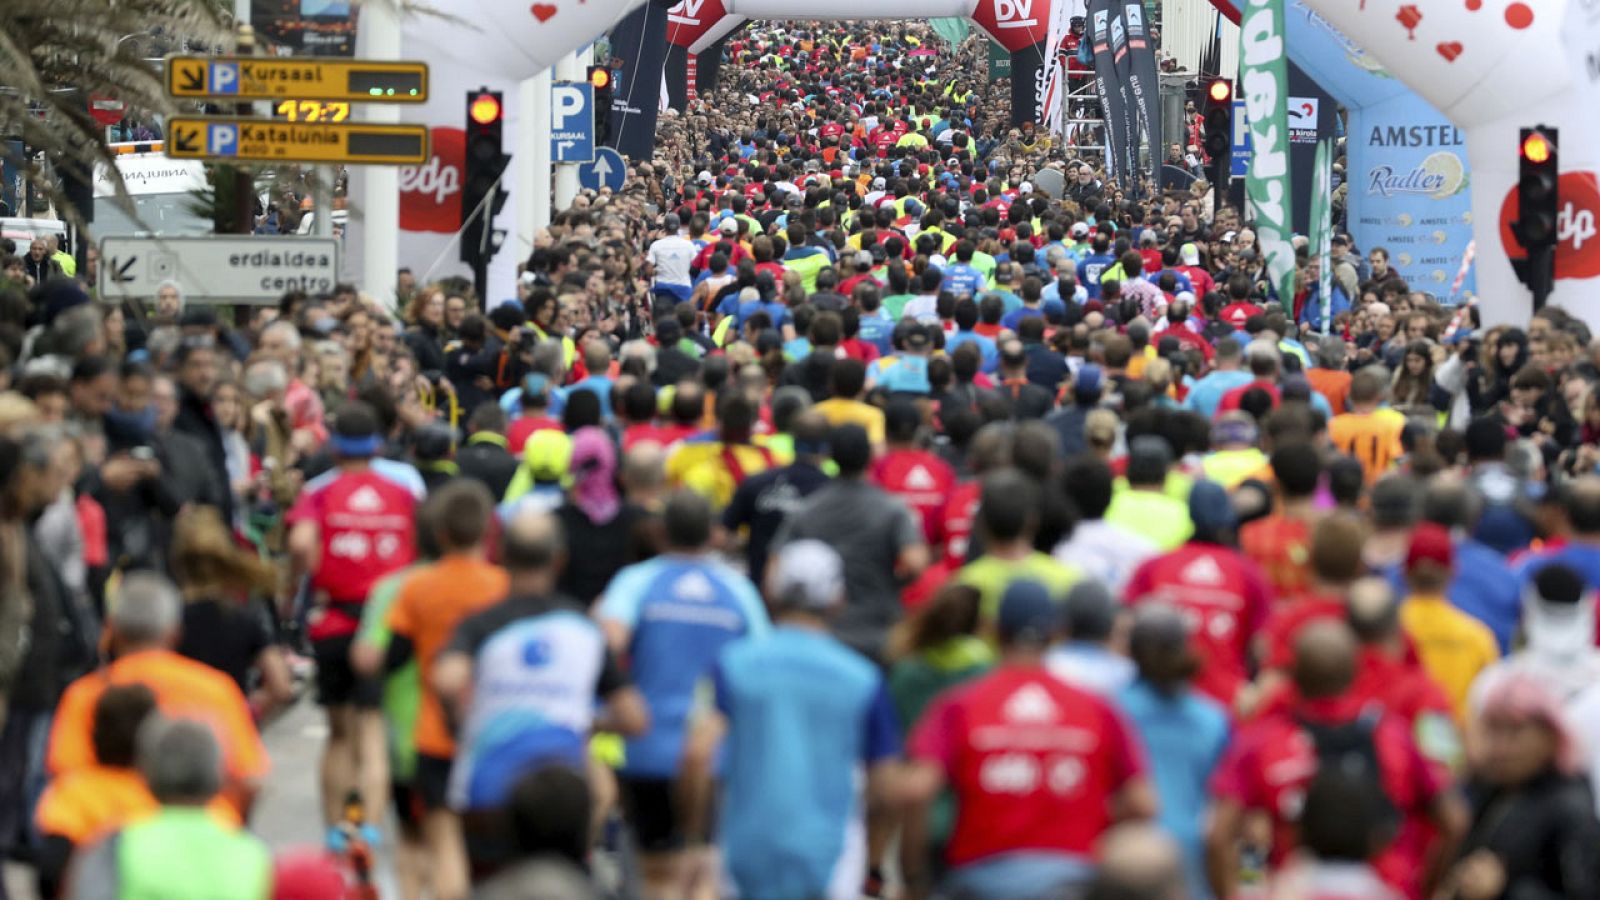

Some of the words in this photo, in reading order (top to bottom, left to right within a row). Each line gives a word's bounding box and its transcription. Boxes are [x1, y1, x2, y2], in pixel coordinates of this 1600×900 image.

[242, 64, 322, 82] Kursaal
[552, 86, 585, 130] P
[242, 126, 340, 145] Katalunia
[1369, 125, 1463, 146] AMSTEL
[399, 156, 459, 204] edp
[1369, 165, 1445, 197] Radler
[1556, 201, 1597, 250] dp
[229, 250, 329, 267] erdialdea
[260, 275, 330, 290] centro
